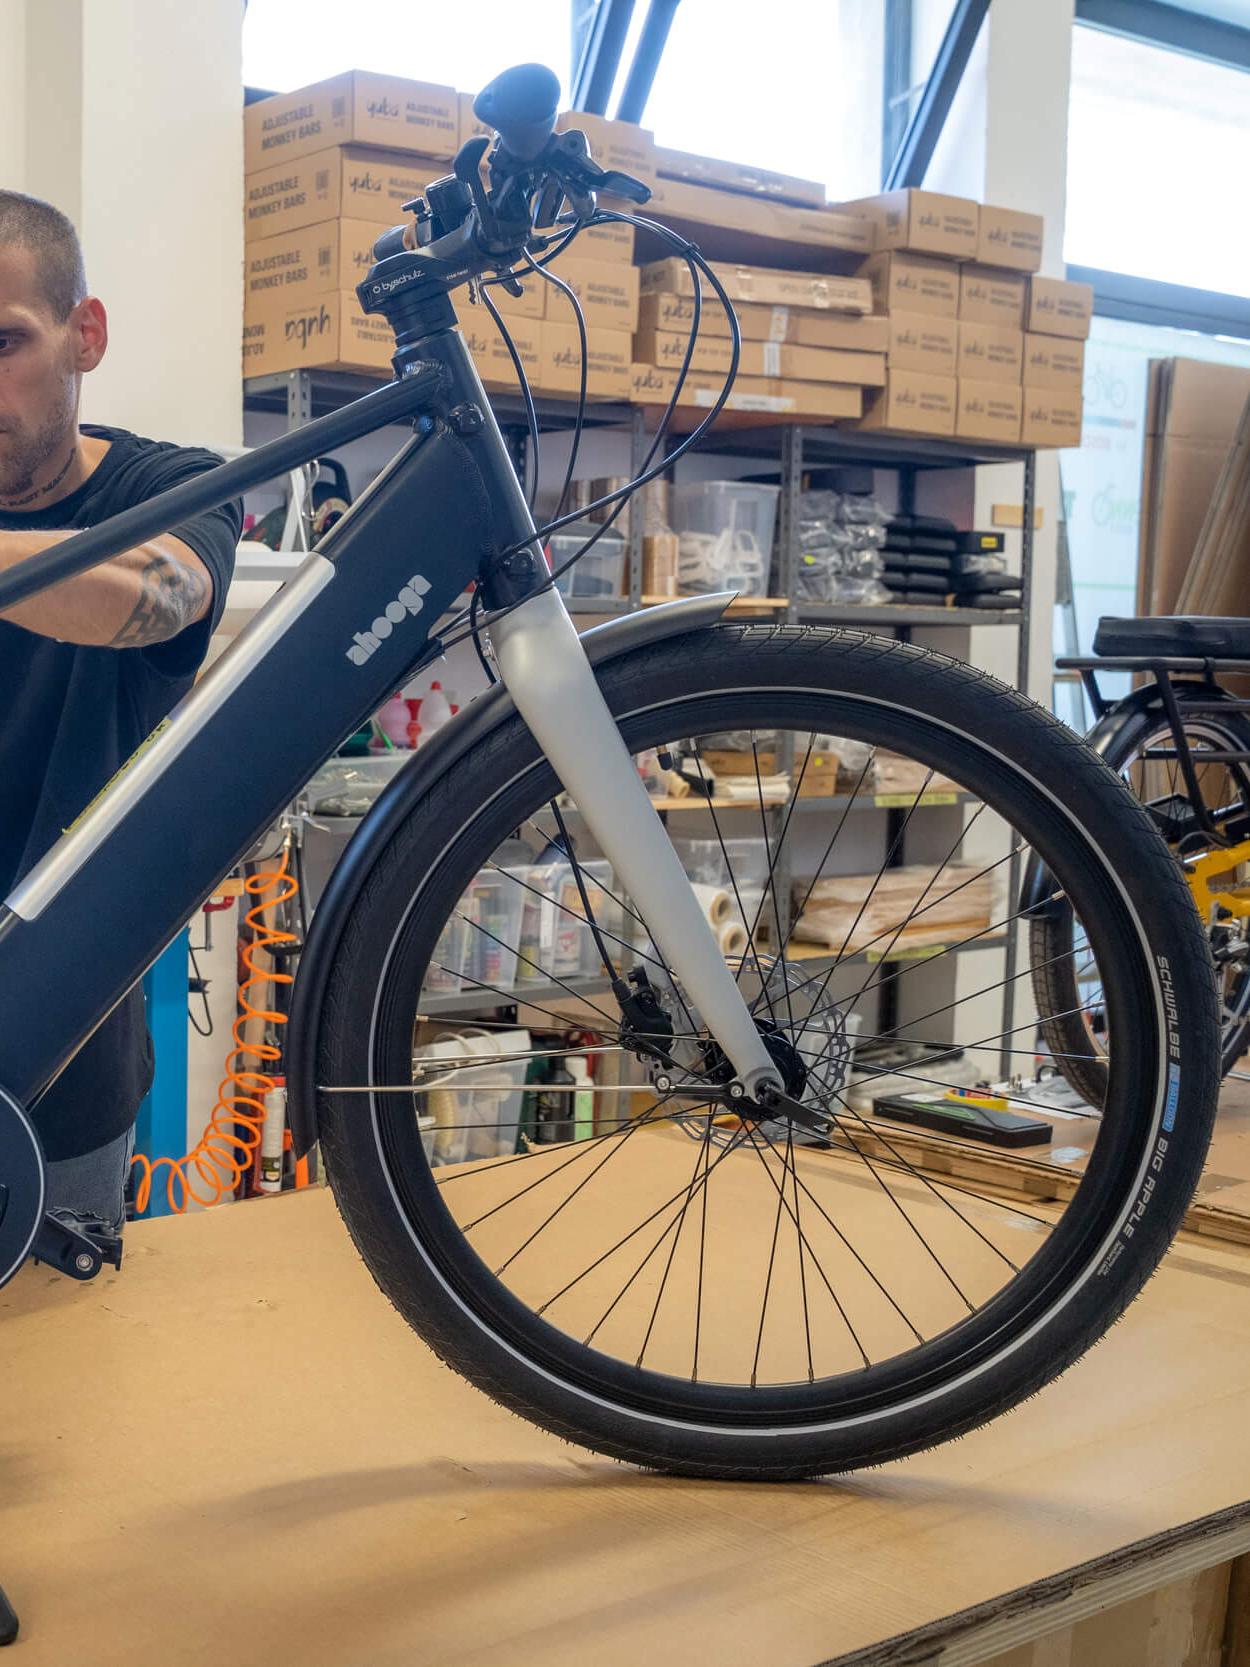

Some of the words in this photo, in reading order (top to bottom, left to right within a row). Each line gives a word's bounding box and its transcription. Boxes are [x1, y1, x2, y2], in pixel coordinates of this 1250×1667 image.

[261, 104, 314, 131] ADJUSTABLE
[261, 125, 297, 150] MONKEY
[299, 120, 321, 139] BARS
[251, 250, 302, 273] ADJUSTABLE
[251, 271, 285, 291] MONKEY
[286, 266, 308, 283] BARS
[1156, 955, 1181, 1060] SCHWALBE
[1151, 1137, 1169, 1172] BIG
[1123, 1175, 1157, 1238] APPLE
